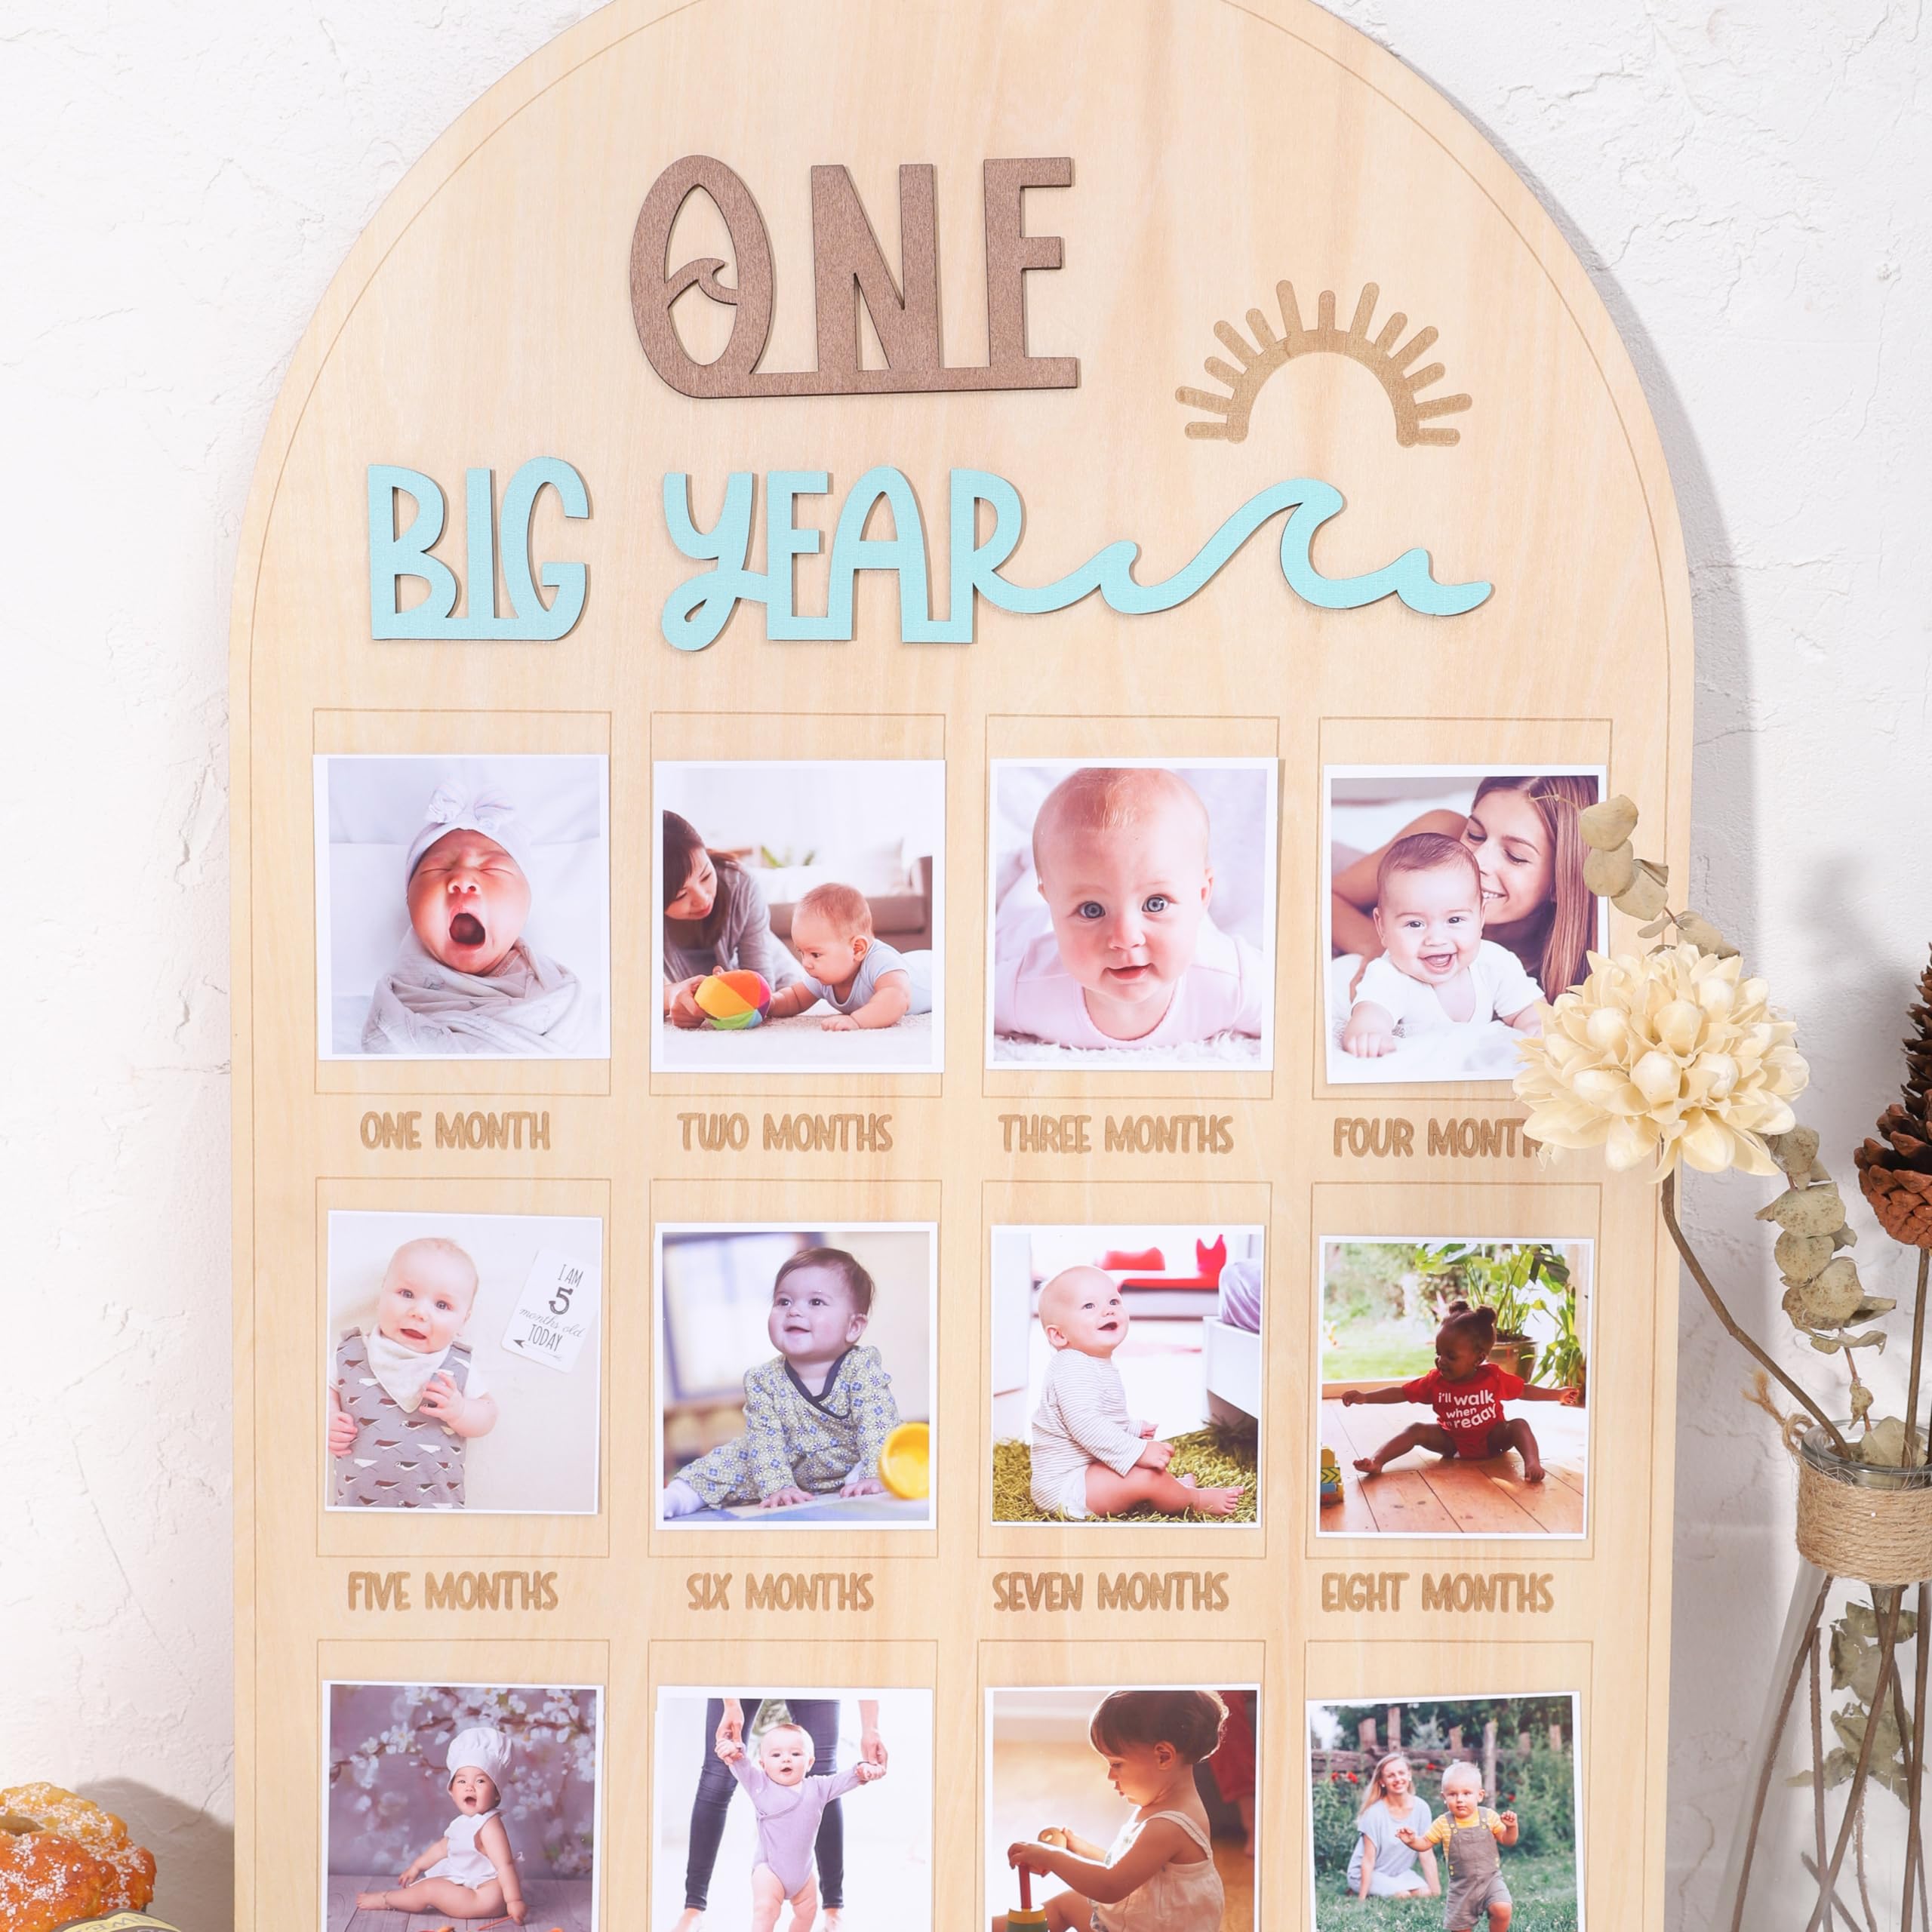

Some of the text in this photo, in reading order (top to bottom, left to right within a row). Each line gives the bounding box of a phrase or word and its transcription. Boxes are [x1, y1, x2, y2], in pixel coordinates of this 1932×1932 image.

[629, 154, 1078, 399] ONE
[368, 457, 1100, 652] BIG YEAR
[360, 1111, 551, 1151] ONE MONTH
[676, 1112, 894, 1152] TWO MONTHS
[998, 1114, 1234, 1155] THREE MONTHS
[1333, 1118, 1541, 1158] FOUR MONT
[558, 1264, 584, 1287] I AM
[549, 1286, 574, 1315] 5
[519, 1309, 585, 1338] months old
[528, 1324, 562, 1352] TODAY
[1438, 1389, 1495, 1405] i'll walk
[1446, 1407, 1477, 1419] when
[347, 1571, 558, 1611] FIVE MONTHS
[687, 1572, 875, 1612] SIX MONTHS
[992, 1571, 1229, 1613] SEVEN MONTHS
[1321, 1571, 1554, 1614] EIGHT MONTHS
